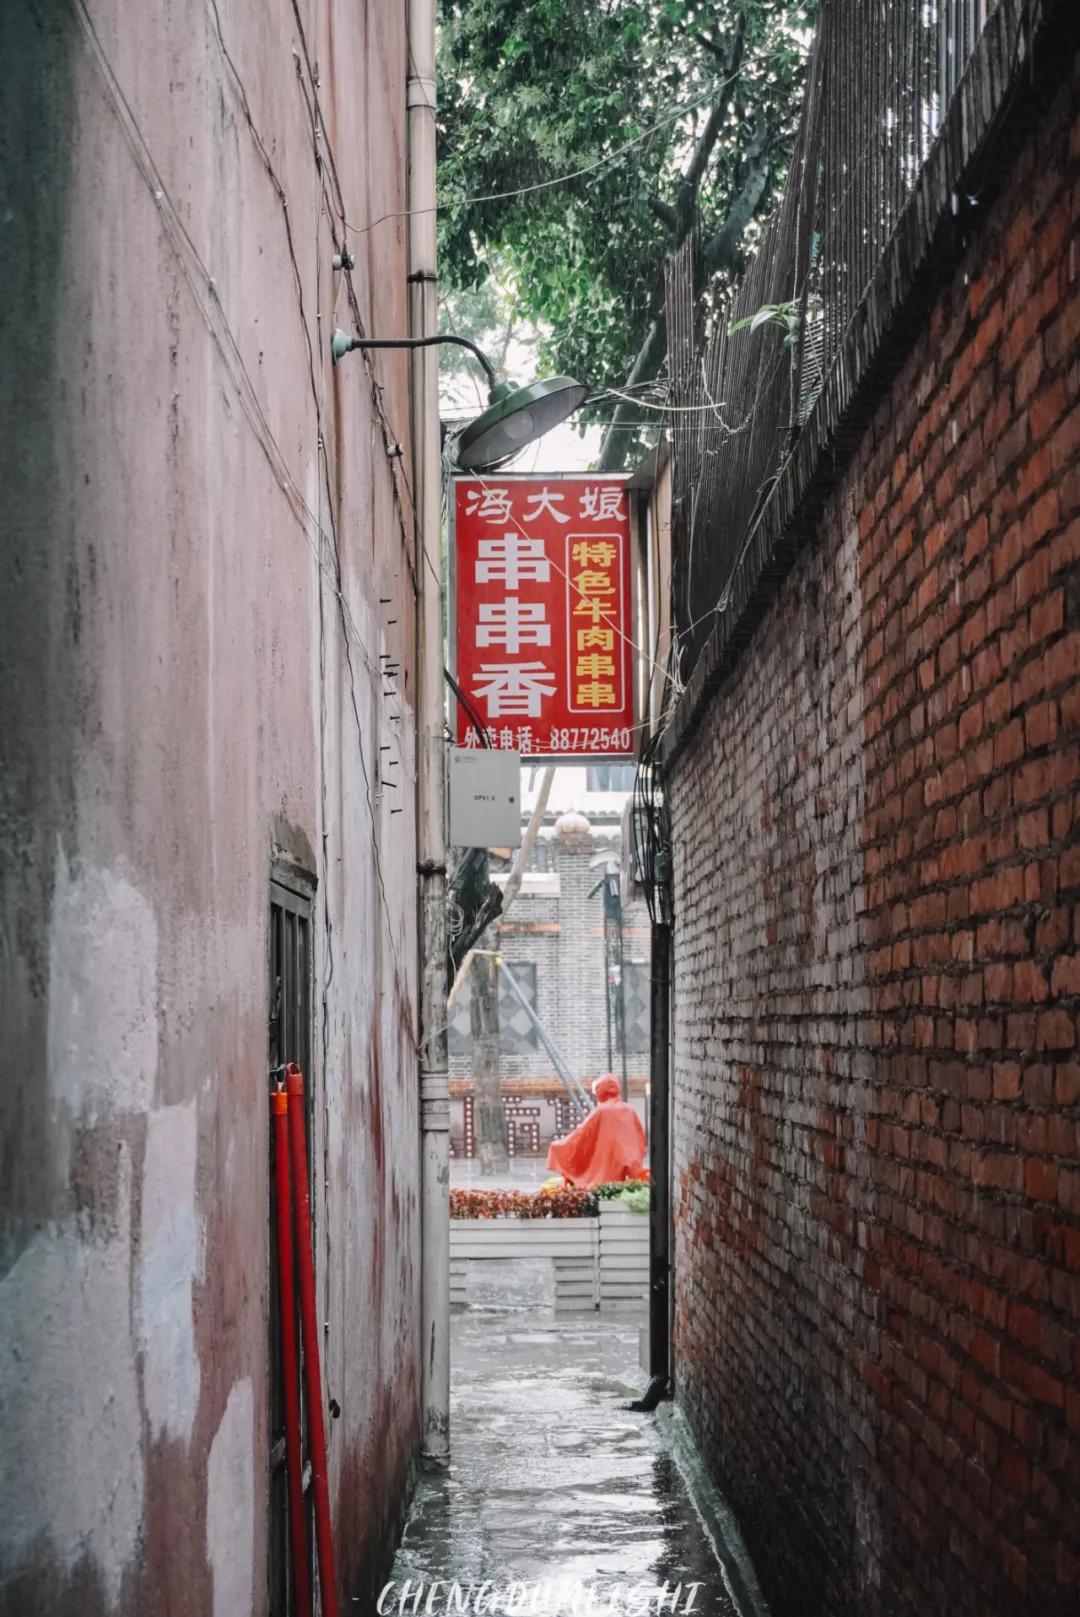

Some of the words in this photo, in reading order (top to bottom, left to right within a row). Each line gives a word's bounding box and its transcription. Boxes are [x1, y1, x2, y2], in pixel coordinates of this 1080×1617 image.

[465, 486, 627, 525] 冯大娘
[470, 532, 558, 719] 串串香
[571, 540, 617, 708] 特色牛肉串串
